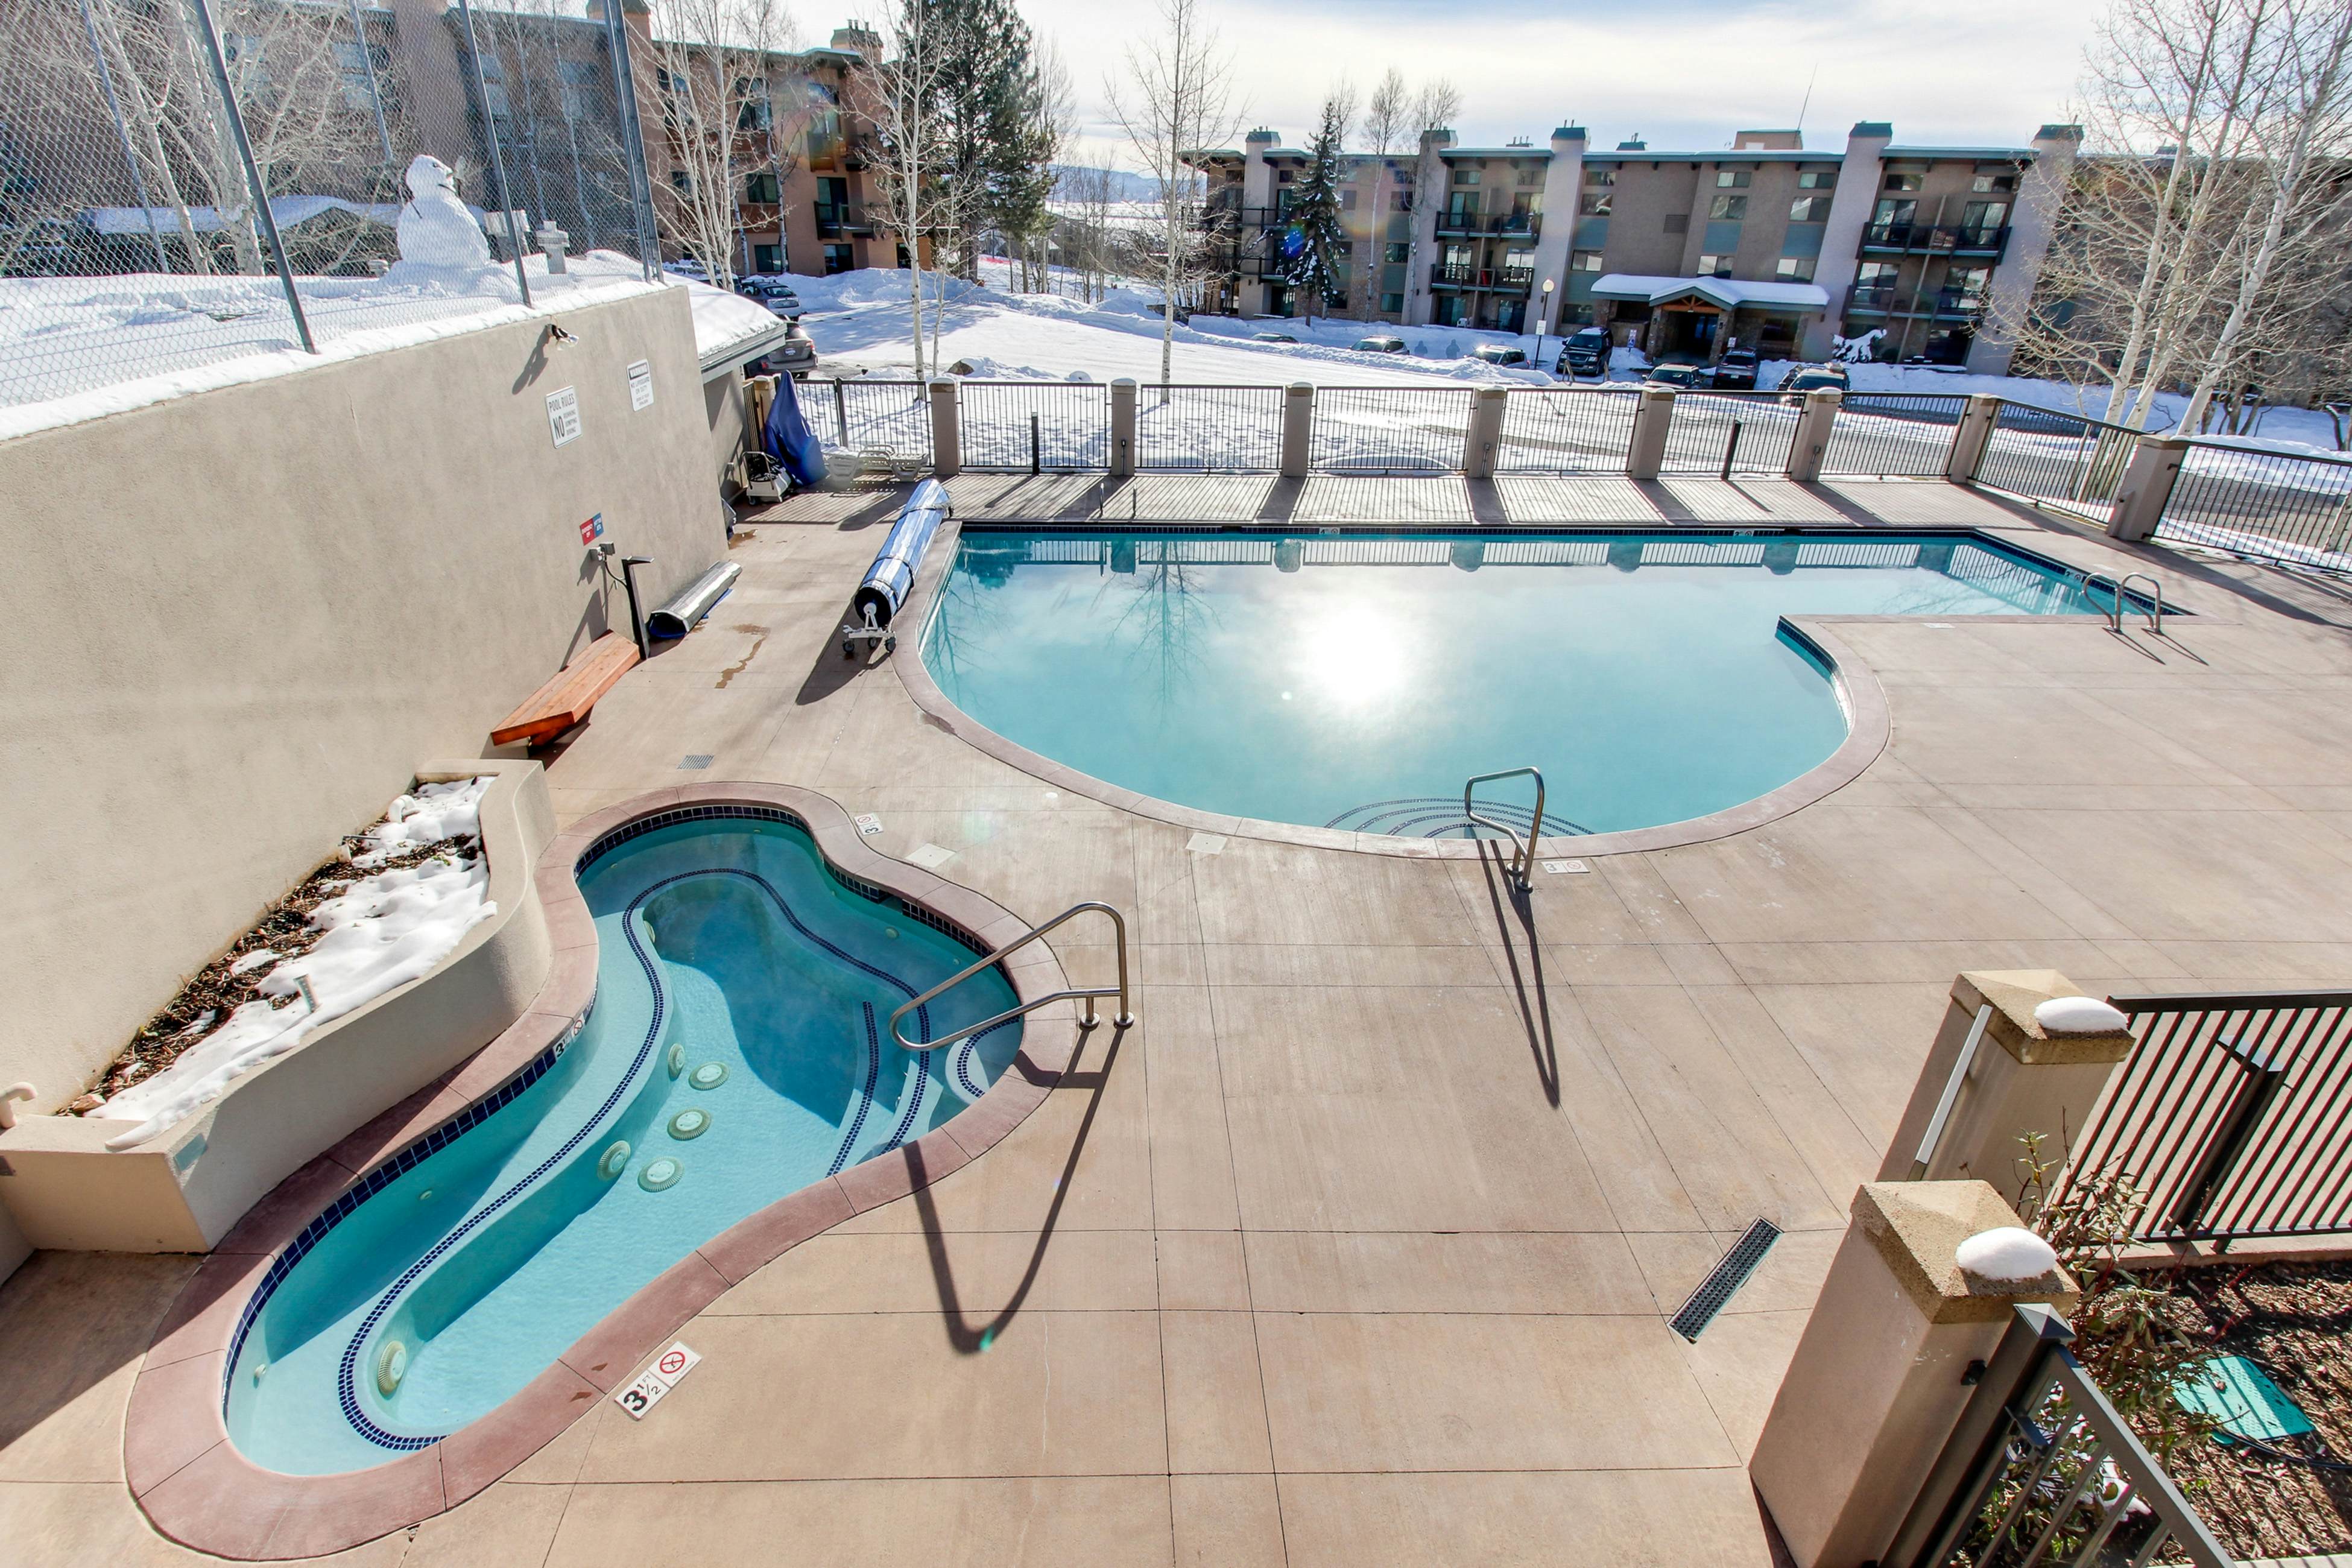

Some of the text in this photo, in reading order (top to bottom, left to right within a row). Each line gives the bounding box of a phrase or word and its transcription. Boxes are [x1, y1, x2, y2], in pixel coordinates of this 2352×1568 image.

[548, 393, 575, 413] POOL RULES
[552, 416, 565, 440] NO
[1545, 863, 1557, 871] 3
[555, 1042, 564, 1057] 3
[624, 1389, 648, 1412] 3
[642, 1374, 651, 1383] FT
